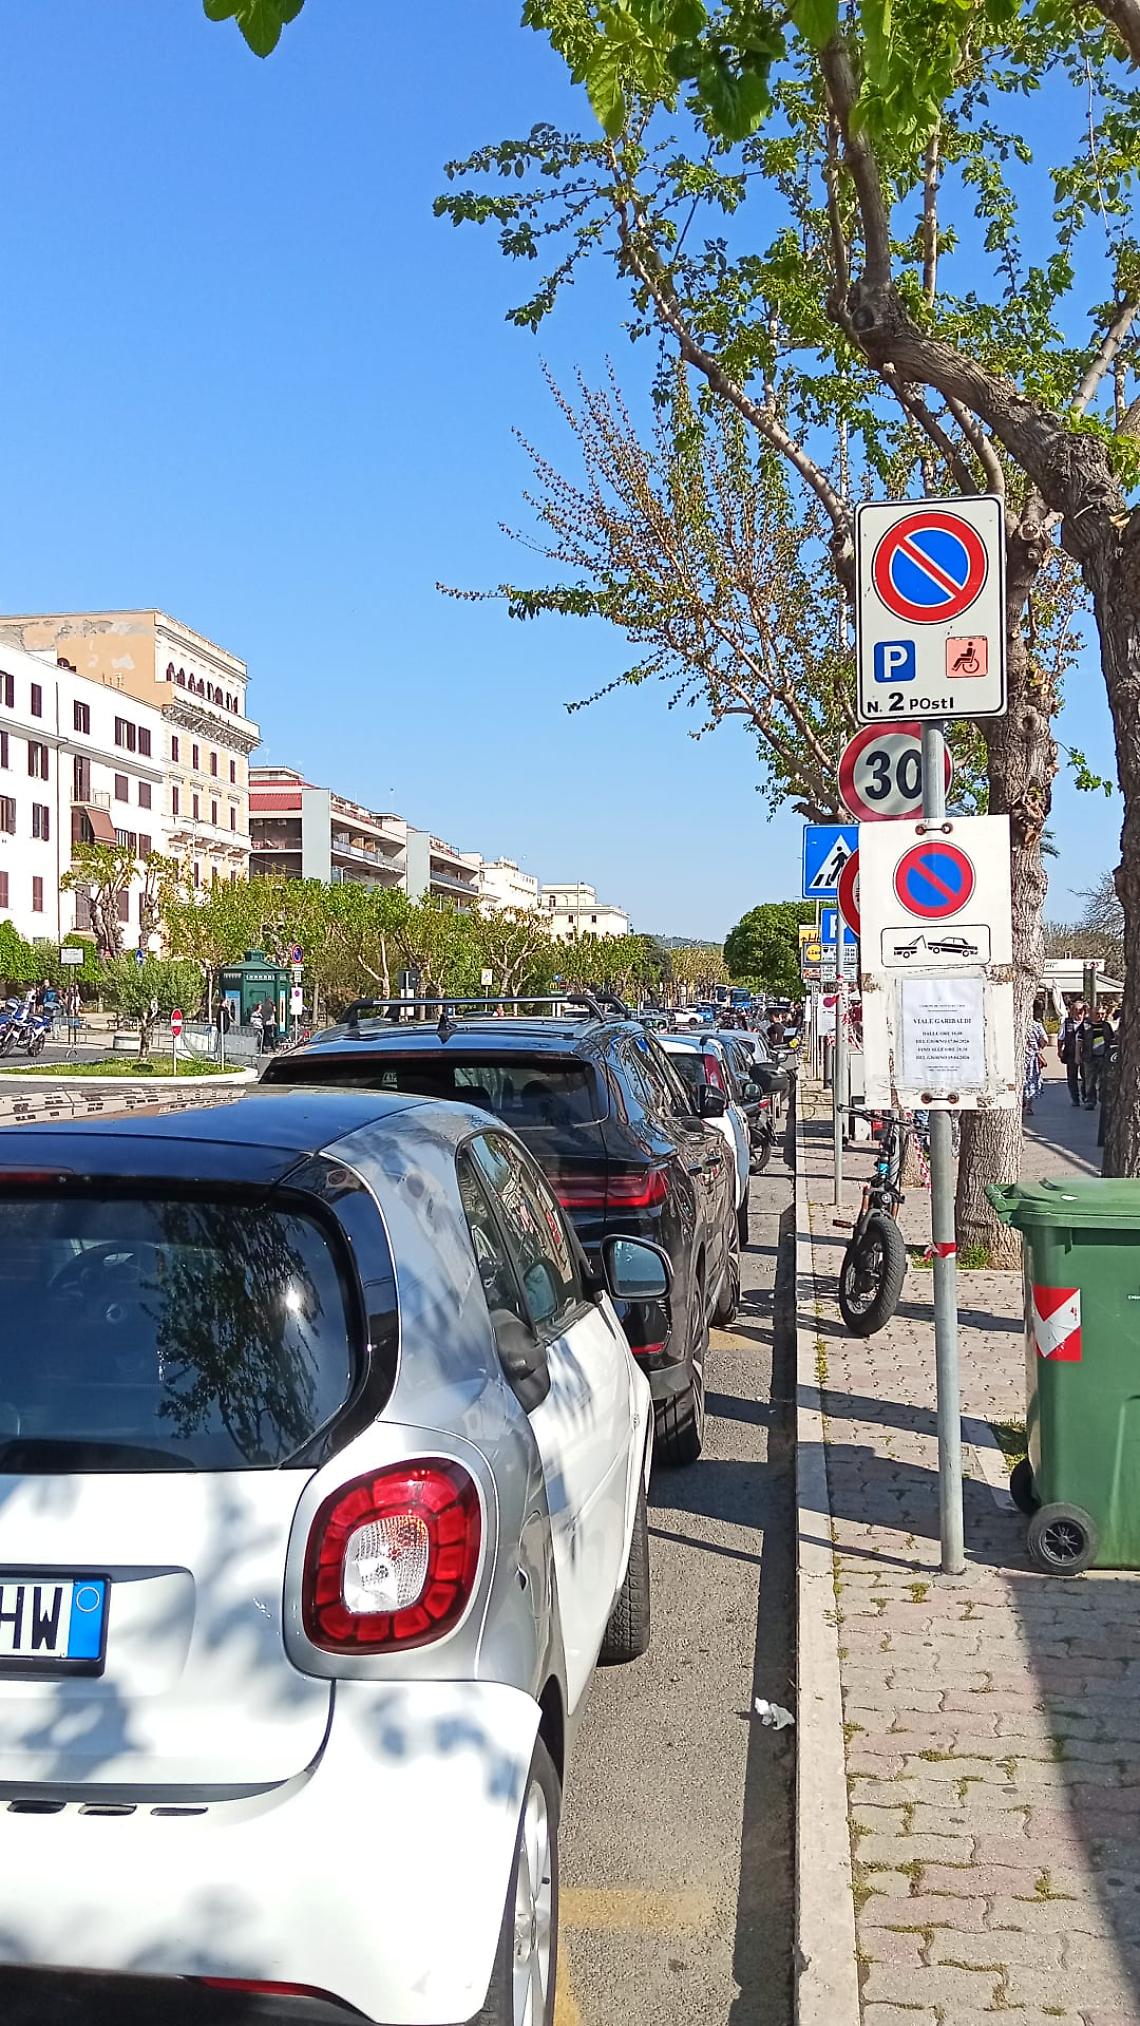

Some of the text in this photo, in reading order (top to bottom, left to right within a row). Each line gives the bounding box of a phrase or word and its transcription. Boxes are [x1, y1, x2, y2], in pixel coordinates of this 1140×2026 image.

[883, 646, 908, 679] P
[867, 701, 883, 713] N.
[888, 692, 904, 712] 2
[864, 749, 923, 801] 30
[0, 1586, 63, 1650] HW
